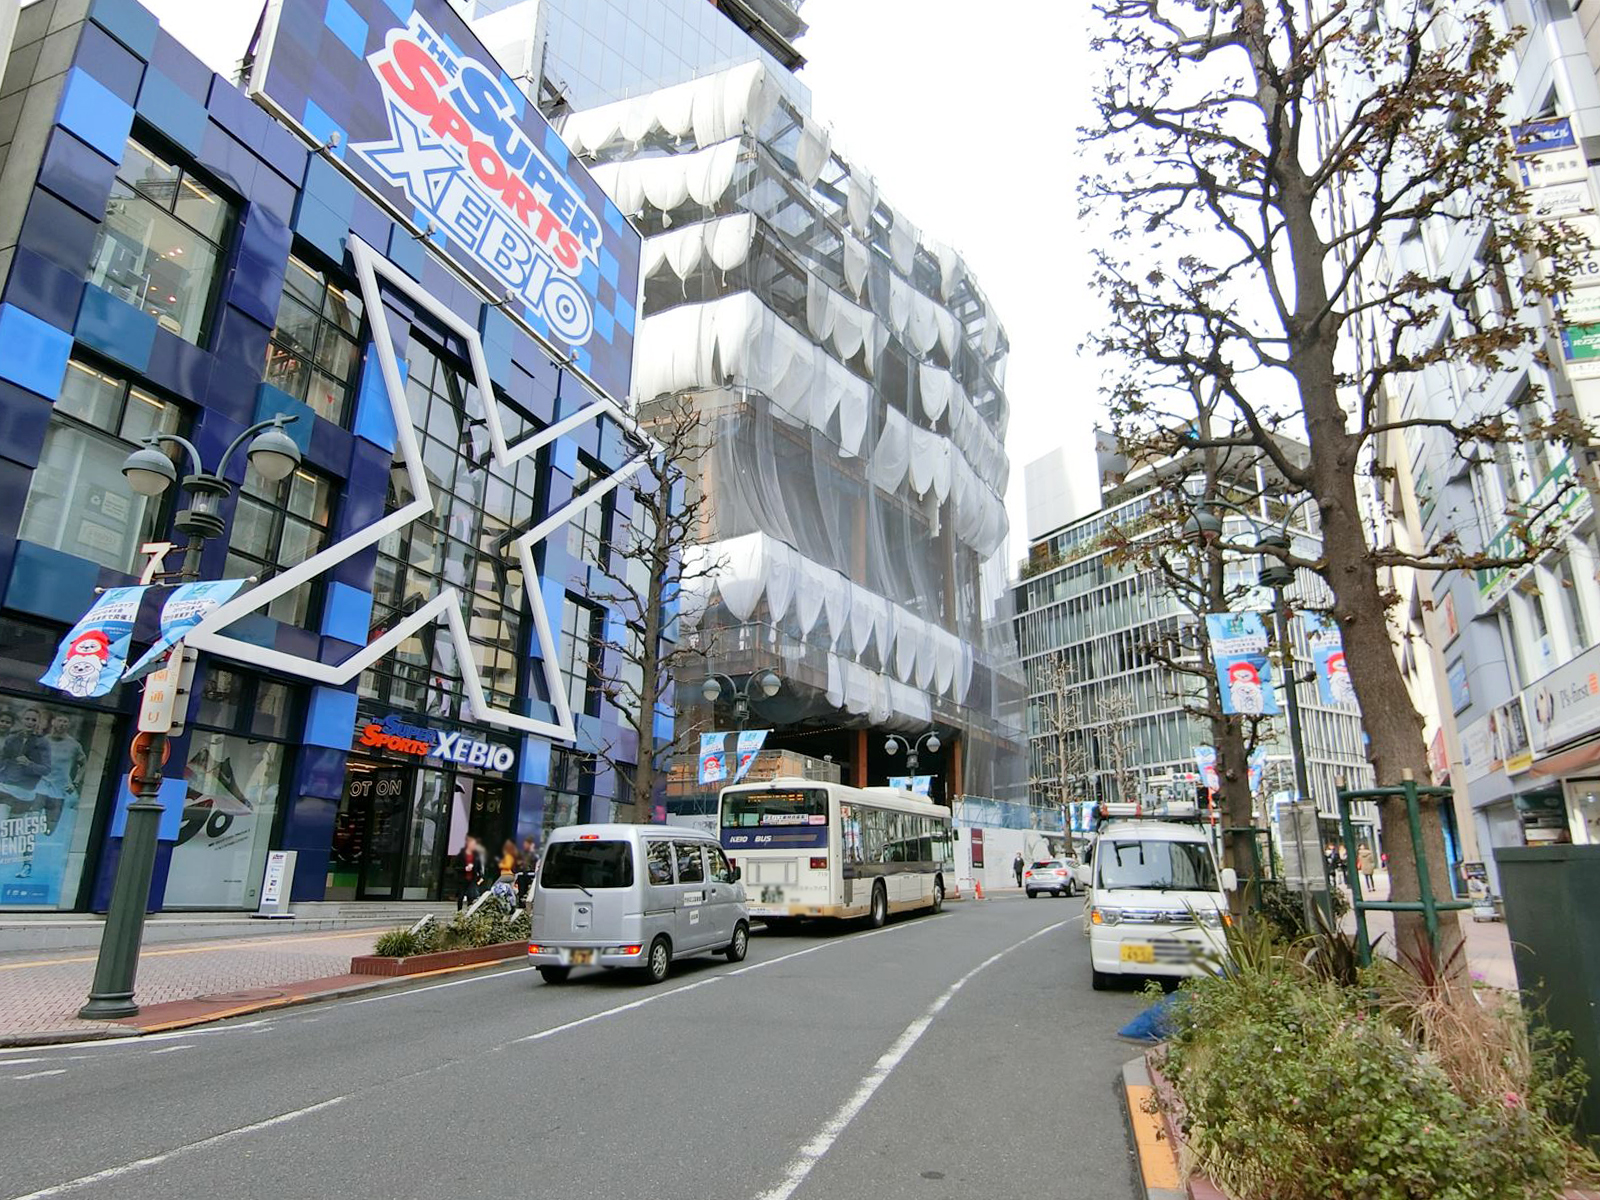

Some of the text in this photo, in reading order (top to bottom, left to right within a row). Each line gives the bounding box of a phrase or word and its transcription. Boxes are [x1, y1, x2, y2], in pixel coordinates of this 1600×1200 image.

[415, 25, 460, 79] THE
[377, 38, 581, 269] SPORTS
[449, 66, 601, 252] SUPER
[363, 103, 592, 341] XEBIO
[359, 724, 515, 772] SPORTS XEBIO
[382, 714, 439, 746] SUPER
[376, 779, 402, 796] ON
[0, 815, 51, 838] STRESS,
[0, 834, 35, 857] ENDS
[754, 835, 772, 843] BUS
